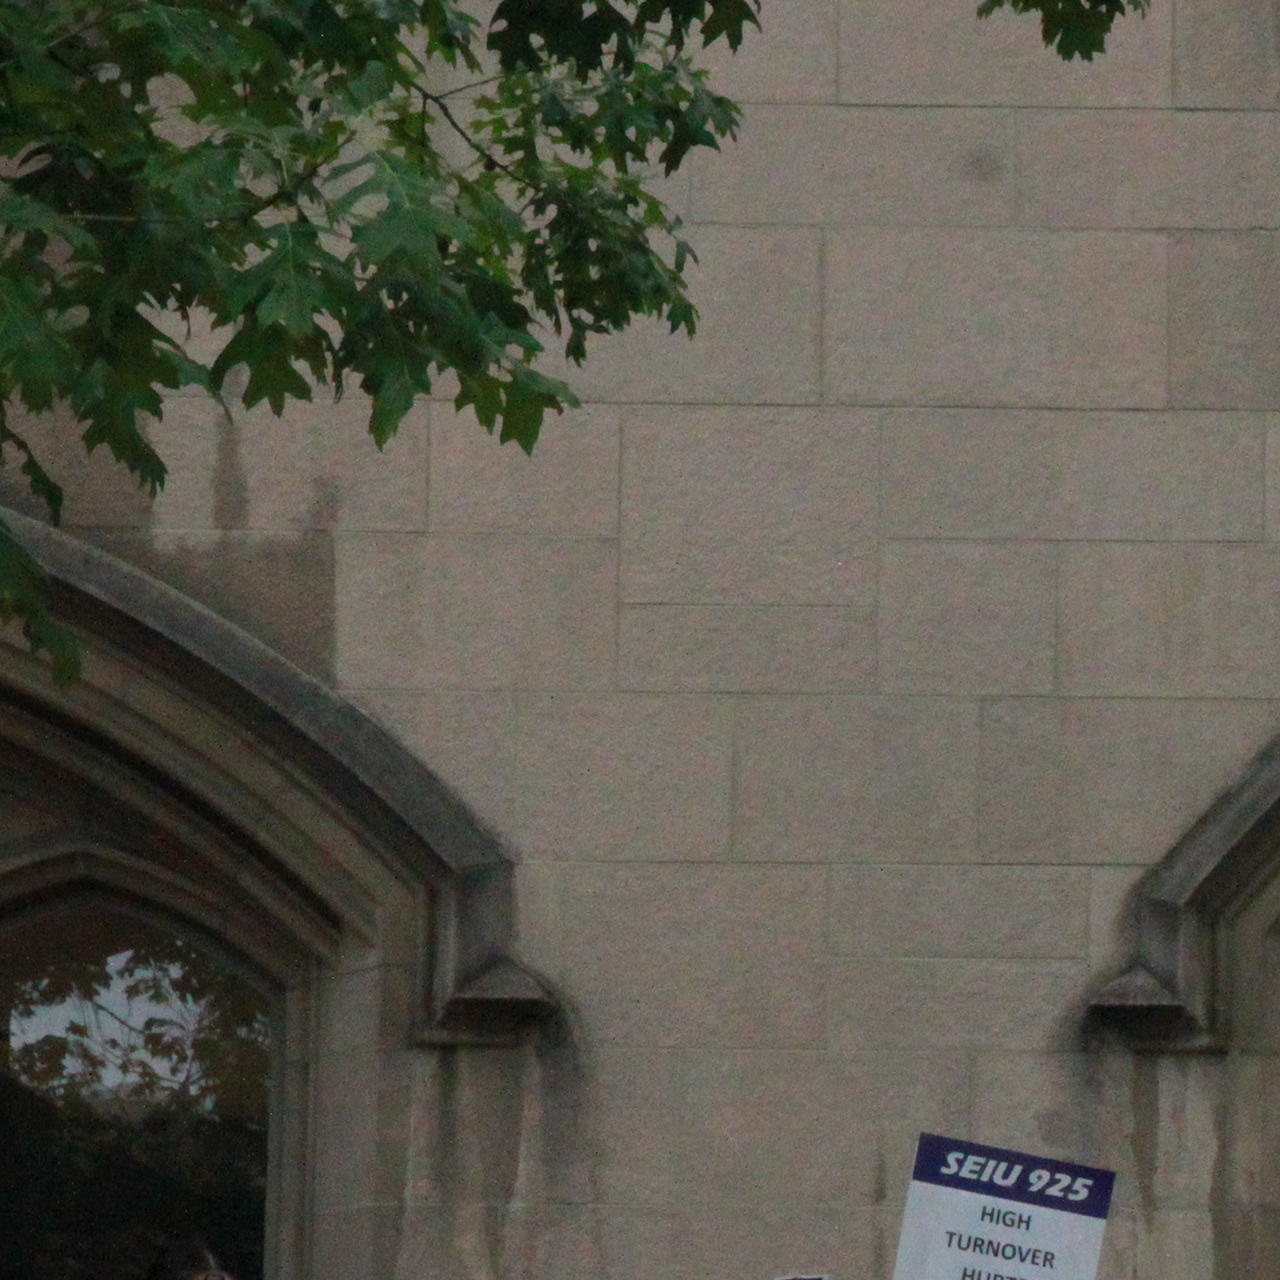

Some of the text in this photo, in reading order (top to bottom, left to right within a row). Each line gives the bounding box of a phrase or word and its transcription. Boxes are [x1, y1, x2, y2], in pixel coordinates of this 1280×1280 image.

[940, 1151, 1094, 1201] SEIU 925
[980, 1205, 1032, 1231] HIGH
[945, 1231, 1056, 1269] TURNOVER
